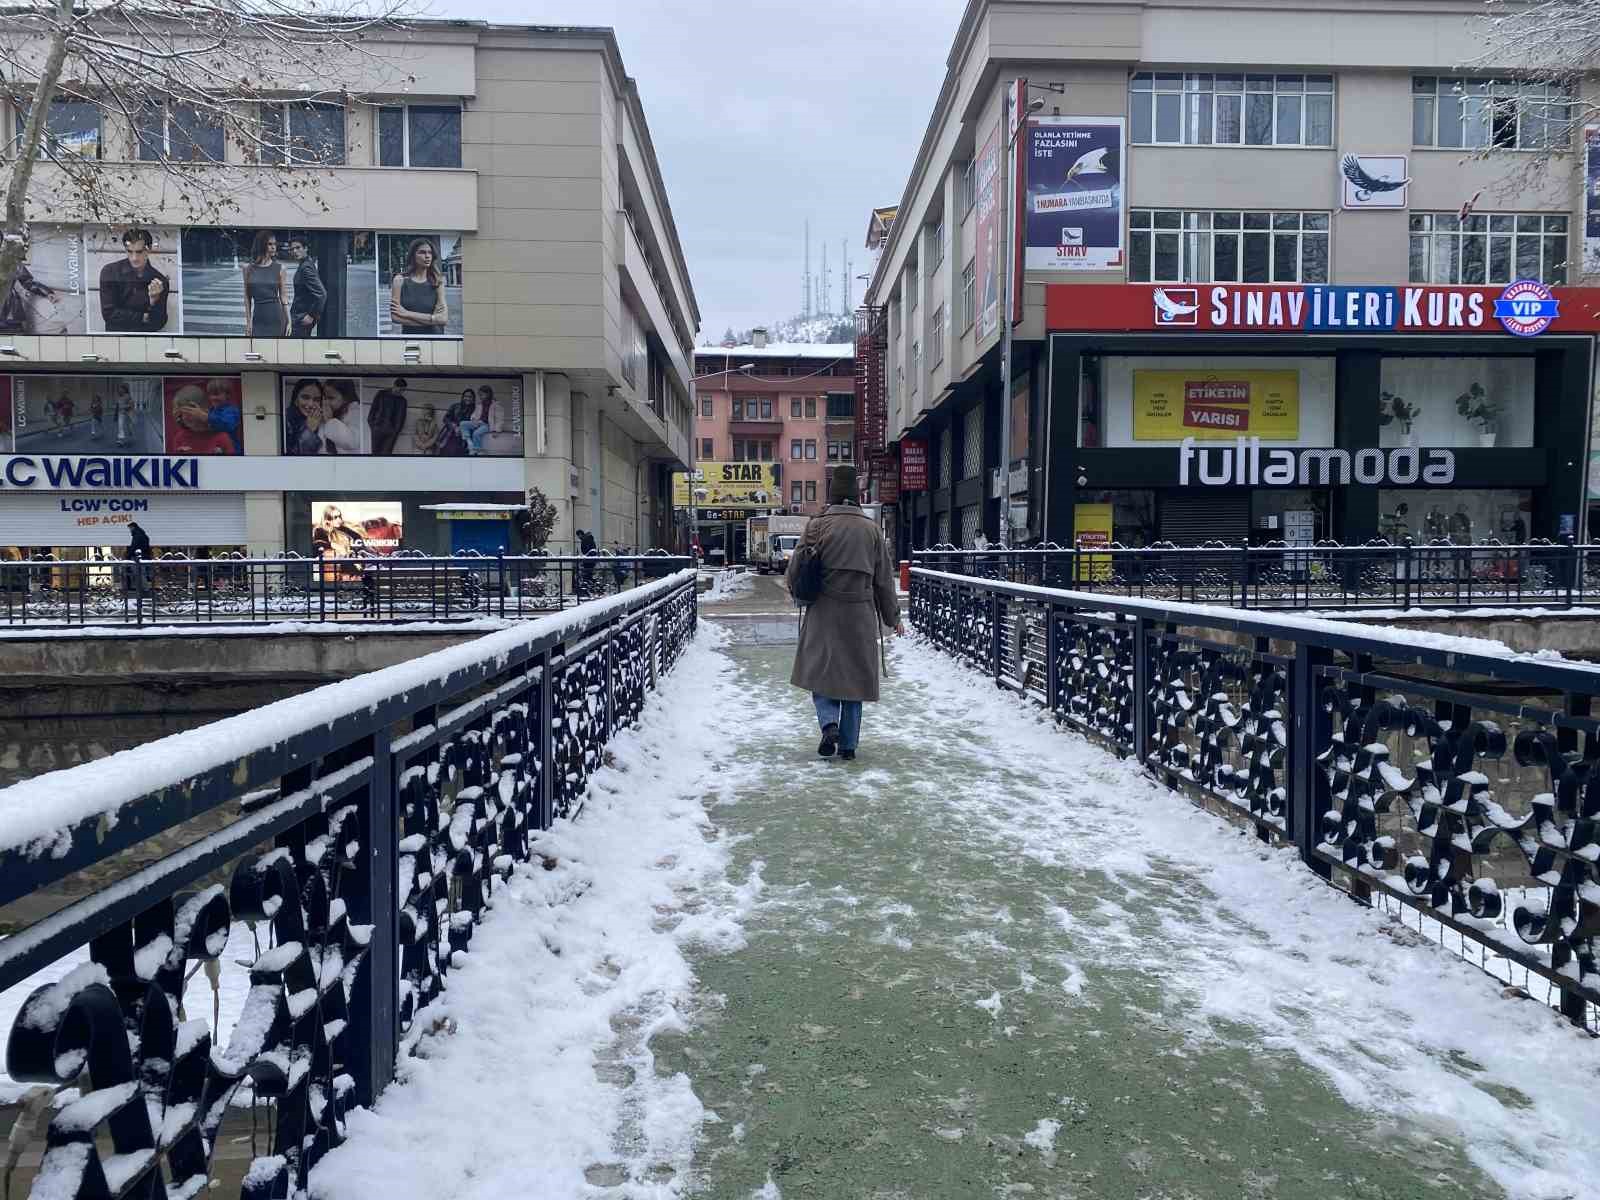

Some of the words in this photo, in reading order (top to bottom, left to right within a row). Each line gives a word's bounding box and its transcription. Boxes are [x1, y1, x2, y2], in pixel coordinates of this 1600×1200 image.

[1034, 131, 1061, 139] OLANLA
[1062, 130, 1092, 139] YETİNME
[1034, 148, 1053, 157] İSTE
[1056, 245, 1088, 257] SINAV
[1210, 286, 1304, 326] SINAV
[1313, 287, 1393, 326] İLERİ
[1404, 287, 1484, 326] KURS
[1512, 302, 1542, 315] VIP
[1189, 384, 1246, 399] ETİKETİN
[1191, 410, 1240, 426] YARISI
[1179, 436, 1455, 486] fullamoda
[0, 457, 36, 486] C
[722, 464, 762, 480] STAR
[78, 516, 99, 526] HEP
